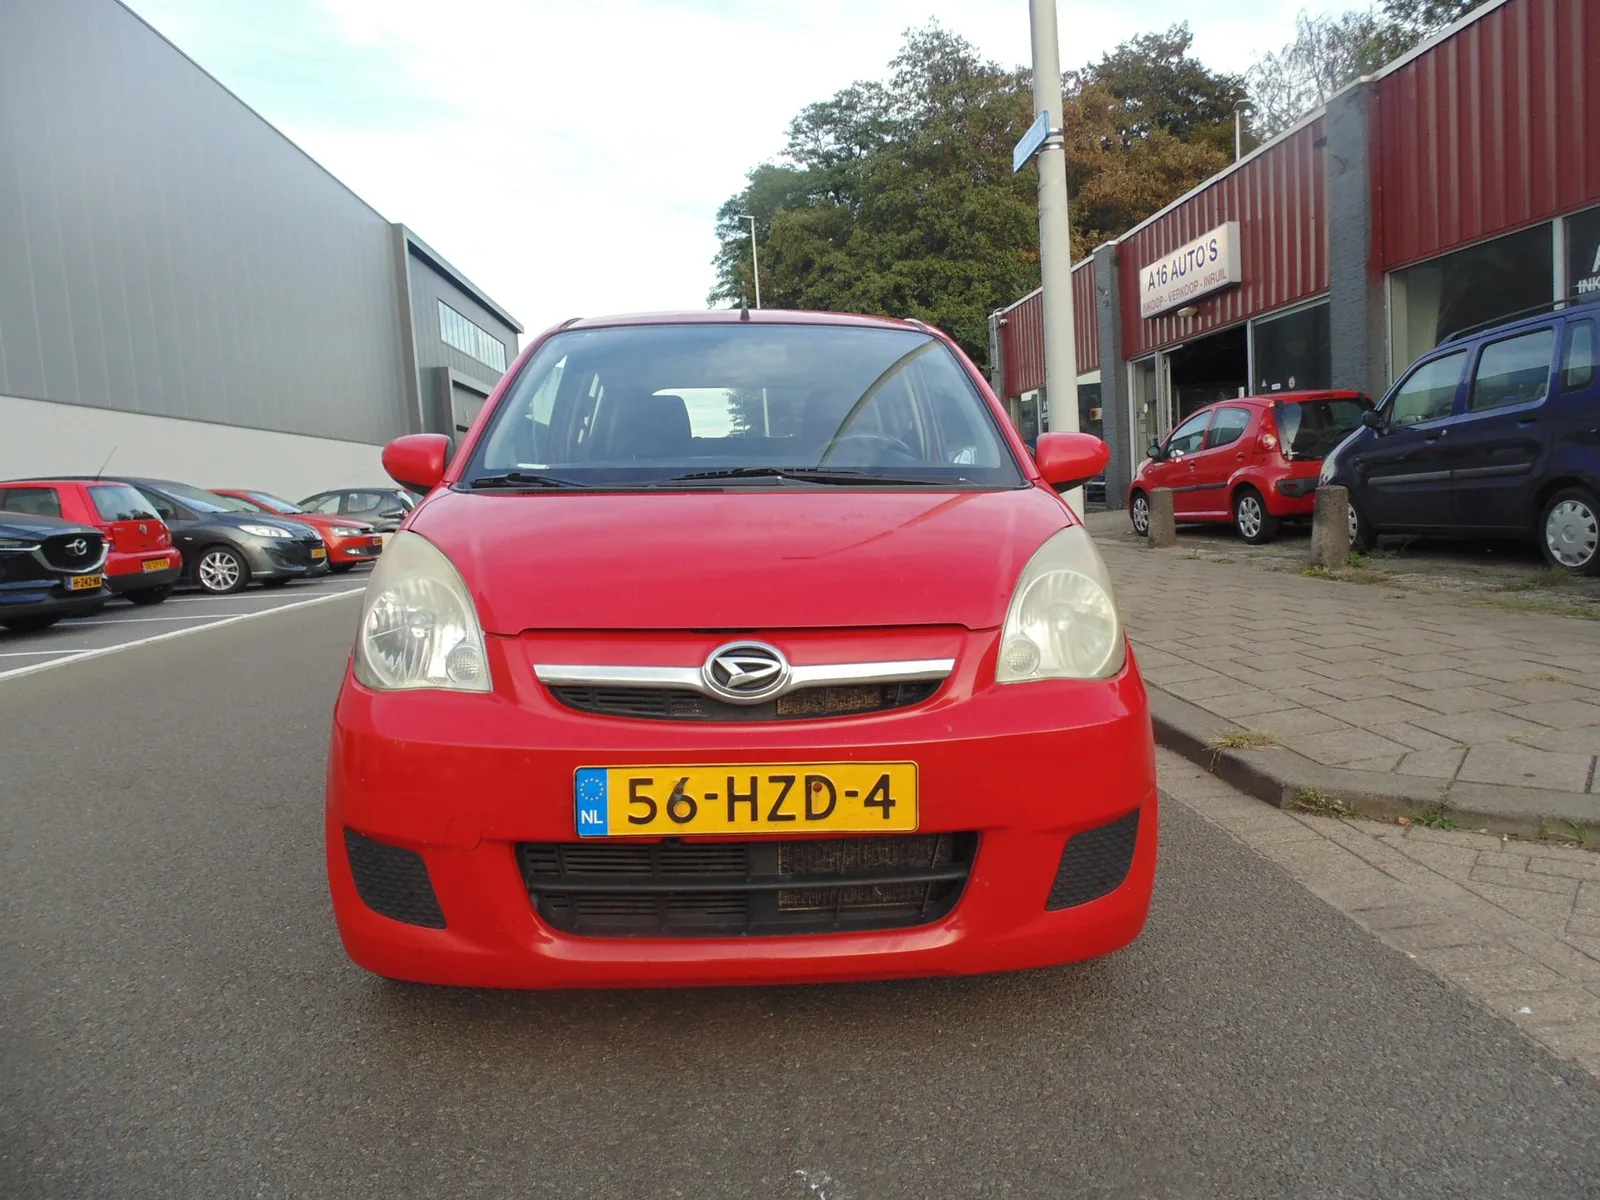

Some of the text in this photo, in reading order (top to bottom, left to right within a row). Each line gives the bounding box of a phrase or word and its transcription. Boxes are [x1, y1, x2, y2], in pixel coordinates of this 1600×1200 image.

[1148, 238, 1218, 291] A16 AUTO'S
[1168, 280, 1199, 302] VERKOOP
[1204, 267, 1227, 288] INRUIL
[581, 809, 604, 824] NL
[627, 773, 896, 825] 56-HZD-4
